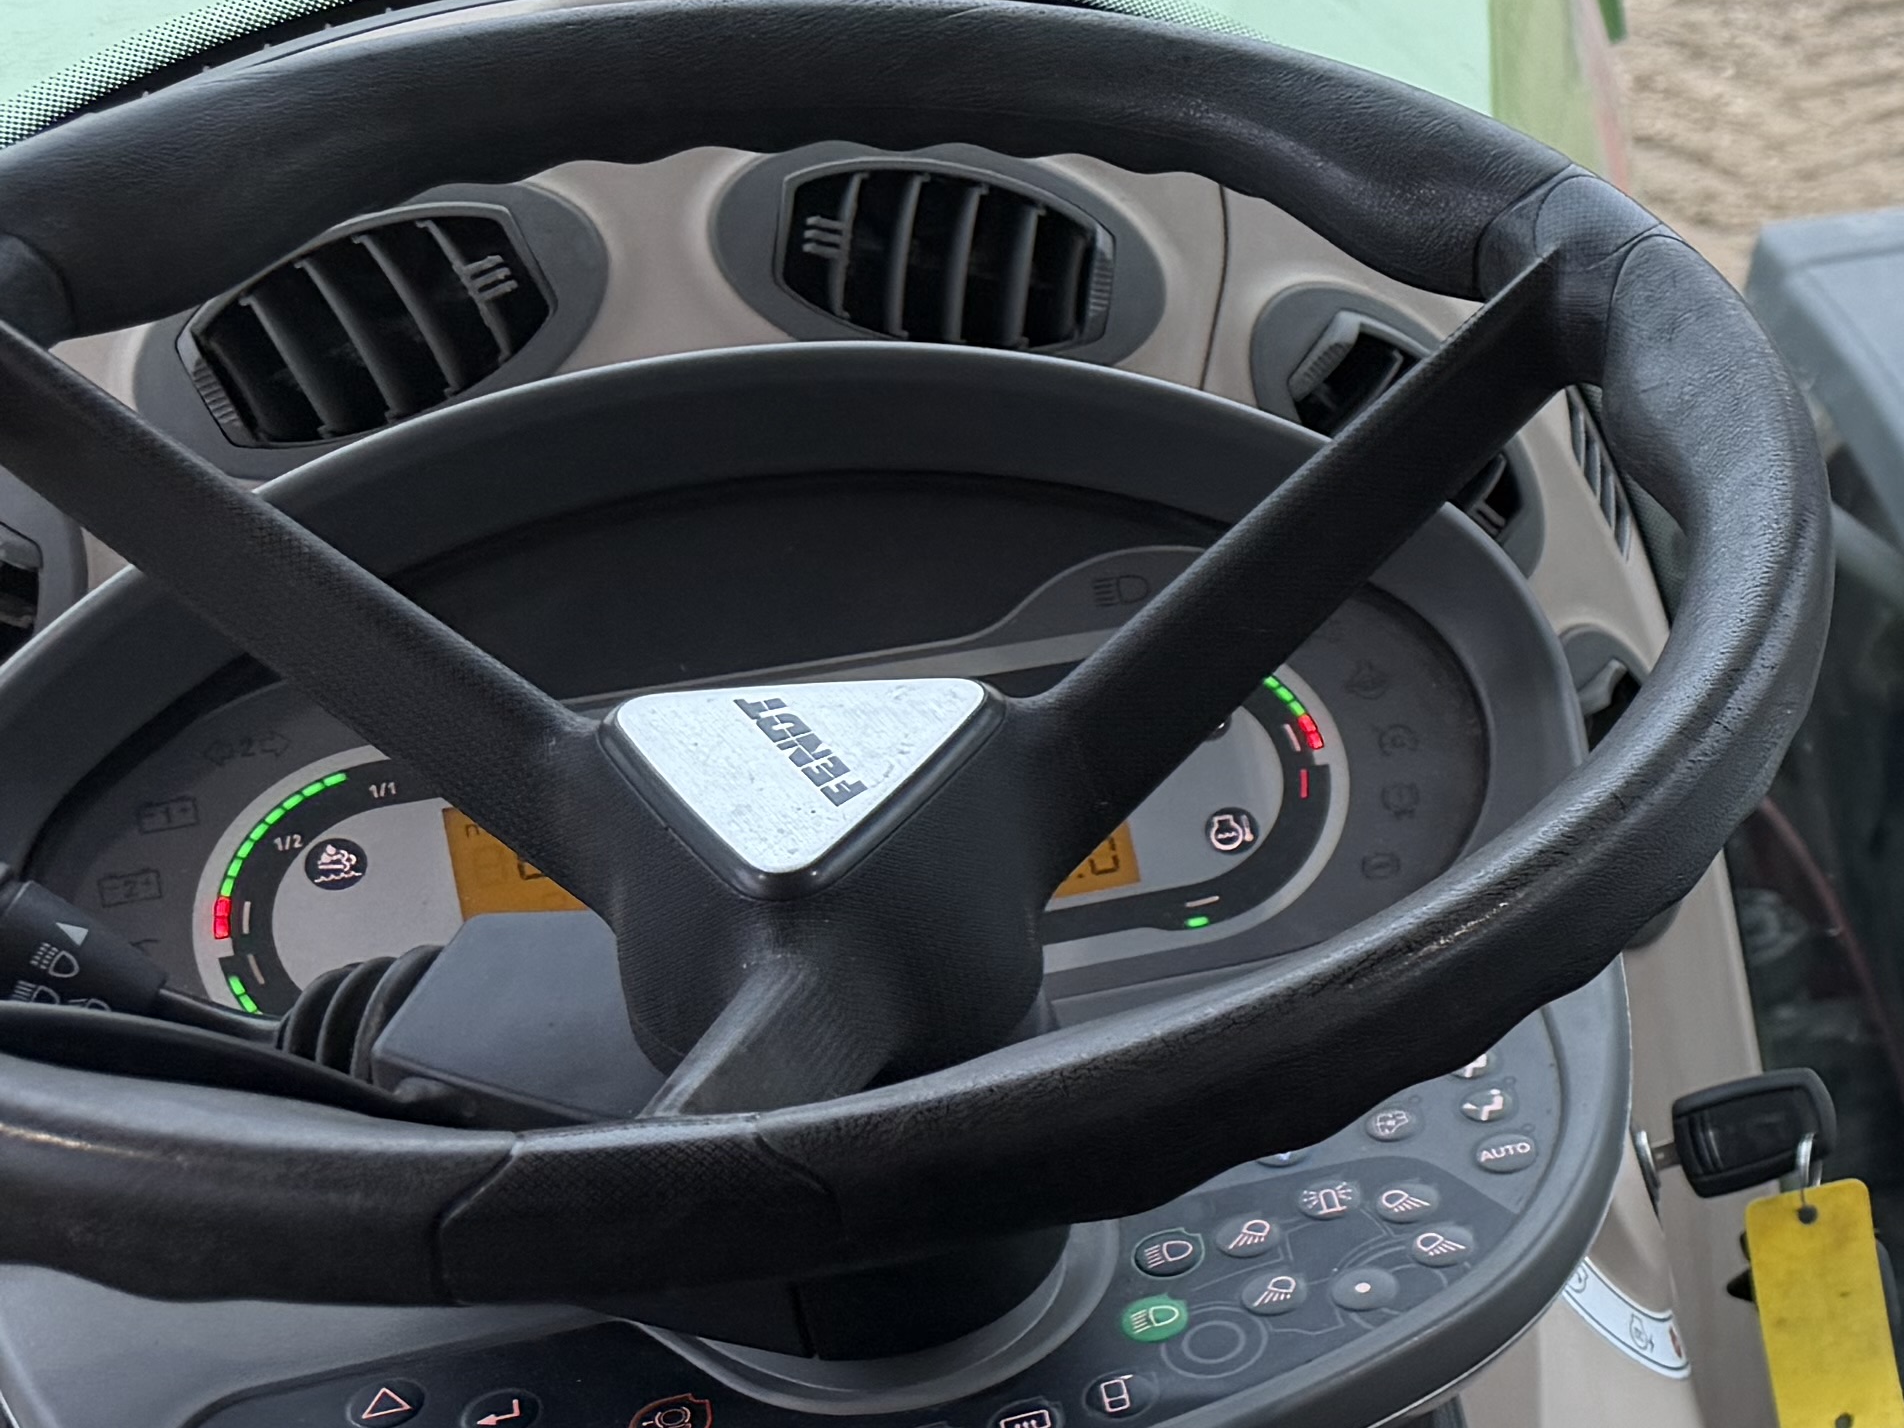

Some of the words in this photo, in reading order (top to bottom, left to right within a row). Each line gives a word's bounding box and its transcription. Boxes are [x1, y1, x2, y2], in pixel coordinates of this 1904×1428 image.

[734, 697, 868, 808] FENDT
[368, 782, 397, 800] 1/1
[274, 834, 303, 852] 1/2
[1480, 1140, 1531, 1162] AUTO
